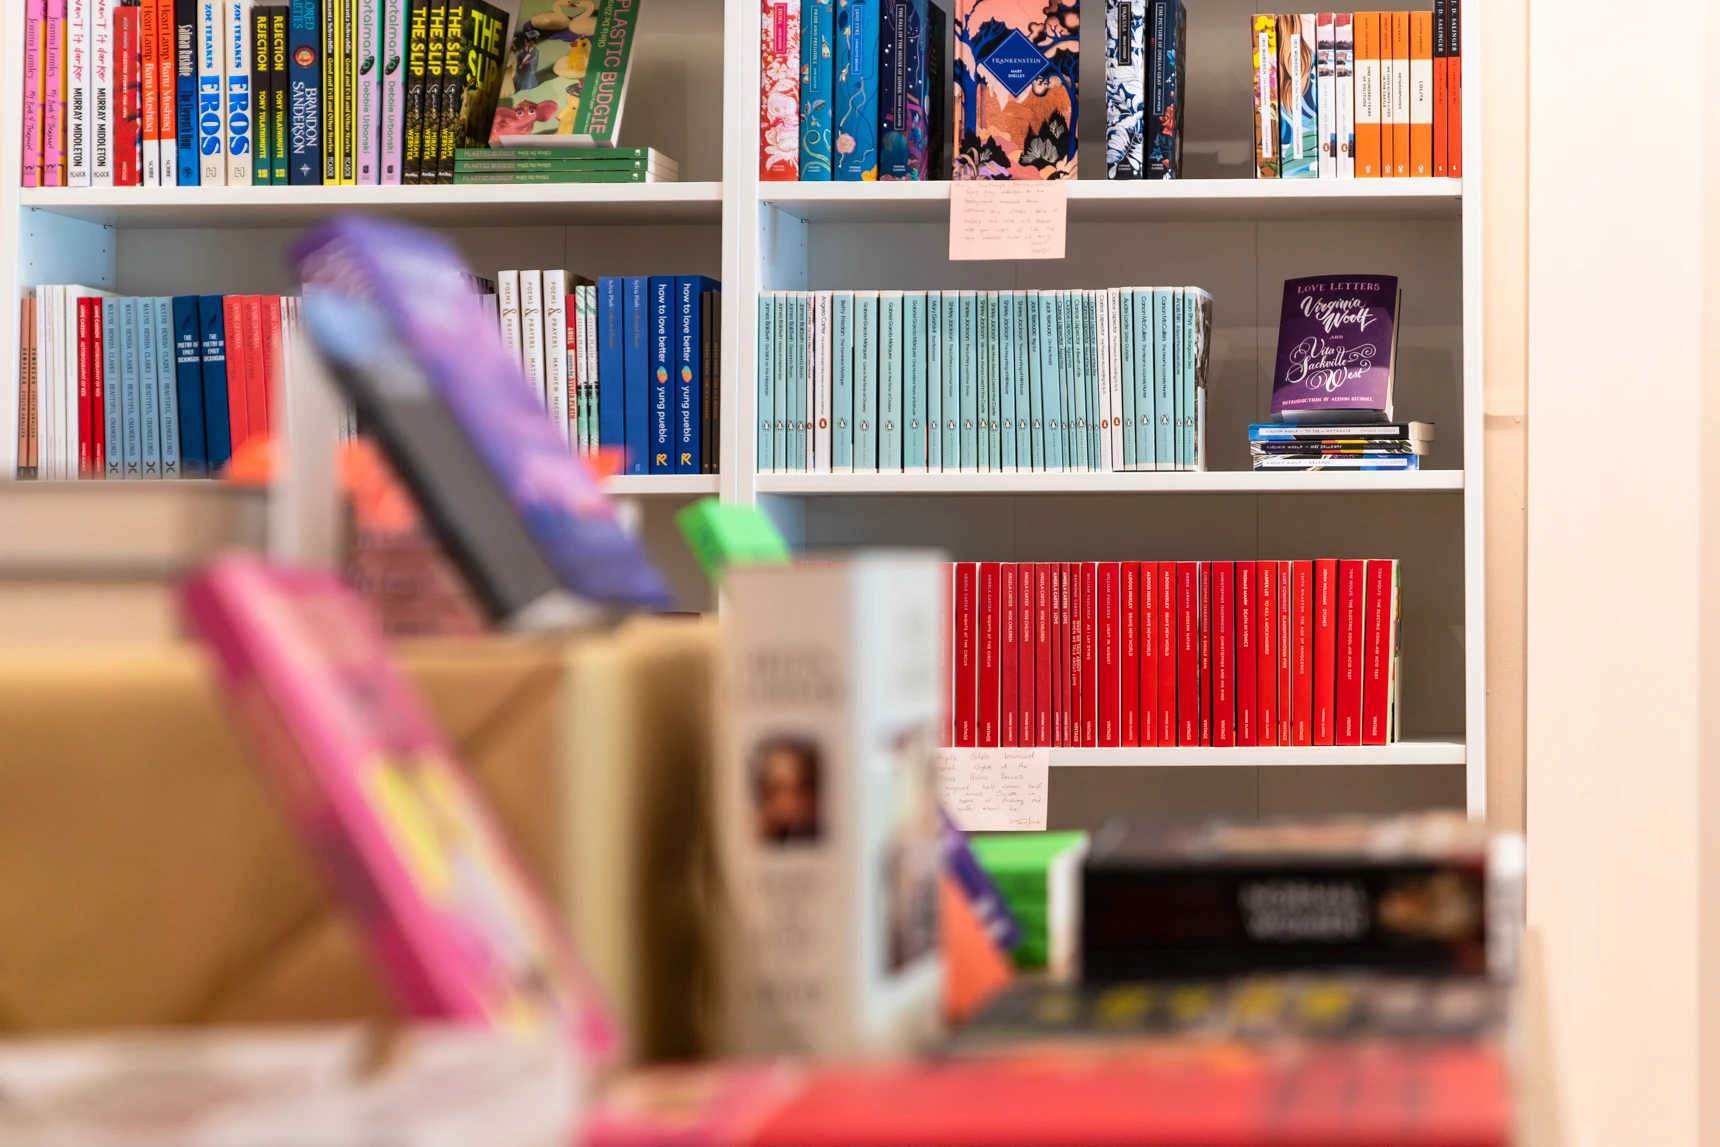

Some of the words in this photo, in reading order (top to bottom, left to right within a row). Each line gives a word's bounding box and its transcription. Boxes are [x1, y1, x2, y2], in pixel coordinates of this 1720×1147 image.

[28, 17, 38, 46] Joanna
[48, 16, 58, 44] Joanna
[143, 5, 153, 30] Heart
[161, 4, 170, 30] Heart
[411, 7, 426, 38] THE
[429, 6, 445, 38] THE
[447, 6, 462, 38] THE
[471, 9, 503, 56] THE
[143, 32, 154, 61] Lamp
[161, 31, 171, 61] Lamp
[178, 24, 193, 52] Salman
[205, 25, 213, 69] TERAKES
[257, 15, 267, 71] REJECTION
[274, 15, 284, 71] REJECTION
[604, 0, 631, 67] PLASTIC
[27, 49, 38, 80] Lumley
[47, 47, 58, 78] Lumley
[178, 53, 193, 77] Rushdie
[410, 43, 425, 76] SLIP
[428, 42, 443, 76] SLIP
[446, 42, 461, 75] SLIP
[466, 49, 498, 93] SLIP
[144, 63, 155, 88] Banu
[162, 62, 172, 87] Banu
[73, 88, 82, 121] MURRAY
[97, 88, 106, 121] MURRAY
[144, 90, 155, 132] Mushtaq
[161, 89, 173, 131] Mushtaq
[363, 81, 371, 112] Debbie
[589, 71, 617, 134] BUDGIE
[200, 75, 221, 156] EROS
[229, 75, 249, 155] EROS
[292, 81, 305, 154] SANDERSON
[304, 88, 317, 147] BRANDON
[73, 124, 82, 166] MIDDLETON
[97, 124, 106, 166] MIDDLETON
[259, 111, 267, 159] TULATHIMUTTE
[363, 115, 371, 153] Urbanski
[658, 284, 666, 303] how
[683, 284, 691, 303] how
[1297, 284, 1325, 293] LOVE
[1330, 282, 1380, 291] LETTERS
[548, 308, 562, 316] &
[658, 305, 666, 314] to
[683, 304, 691, 313] to
[1300, 295, 1365, 321] Virginia
[1322, 308, 1377, 333] Woolf
[658, 316, 666, 334] love
[683, 315, 691, 333] love
[658, 336, 667, 362] better
[683, 336, 691, 361] better
[1306, 359, 1371, 392] West
[657, 387, 665, 409] yung
[682, 386, 690, 409] yung
[1282, 397, 1322, 406] INTRODUCTION
[657, 411, 667, 443] pueblo
[682, 411, 691, 442] pueblo
